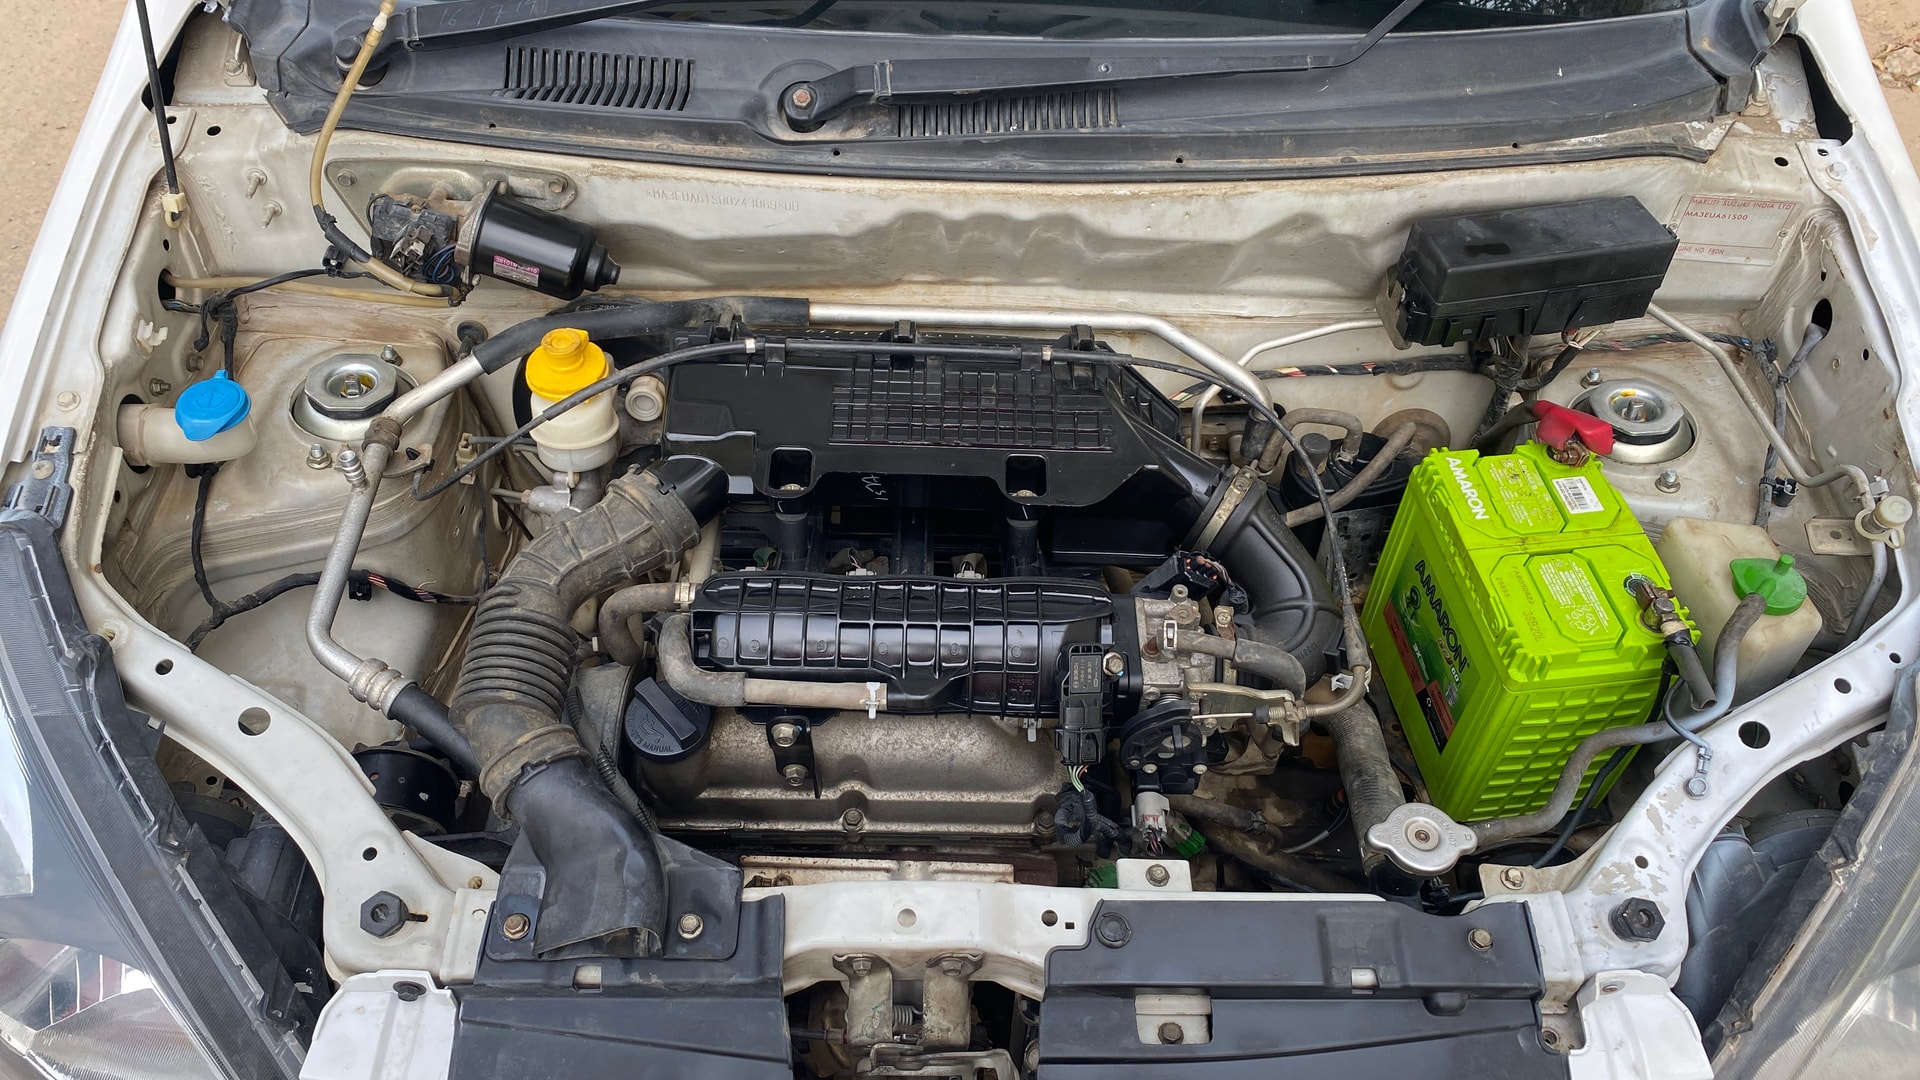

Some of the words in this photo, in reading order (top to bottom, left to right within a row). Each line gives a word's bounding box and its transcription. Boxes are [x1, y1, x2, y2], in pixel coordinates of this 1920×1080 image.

[1691, 199, 1719, 207] MARUTI
[1722, 200, 1750, 208] SUZUKI
[1446, 456, 1490, 519] AMARON
[1415, 560, 1468, 674] AMARON
[641, 741, 673, 752] MANUAL
